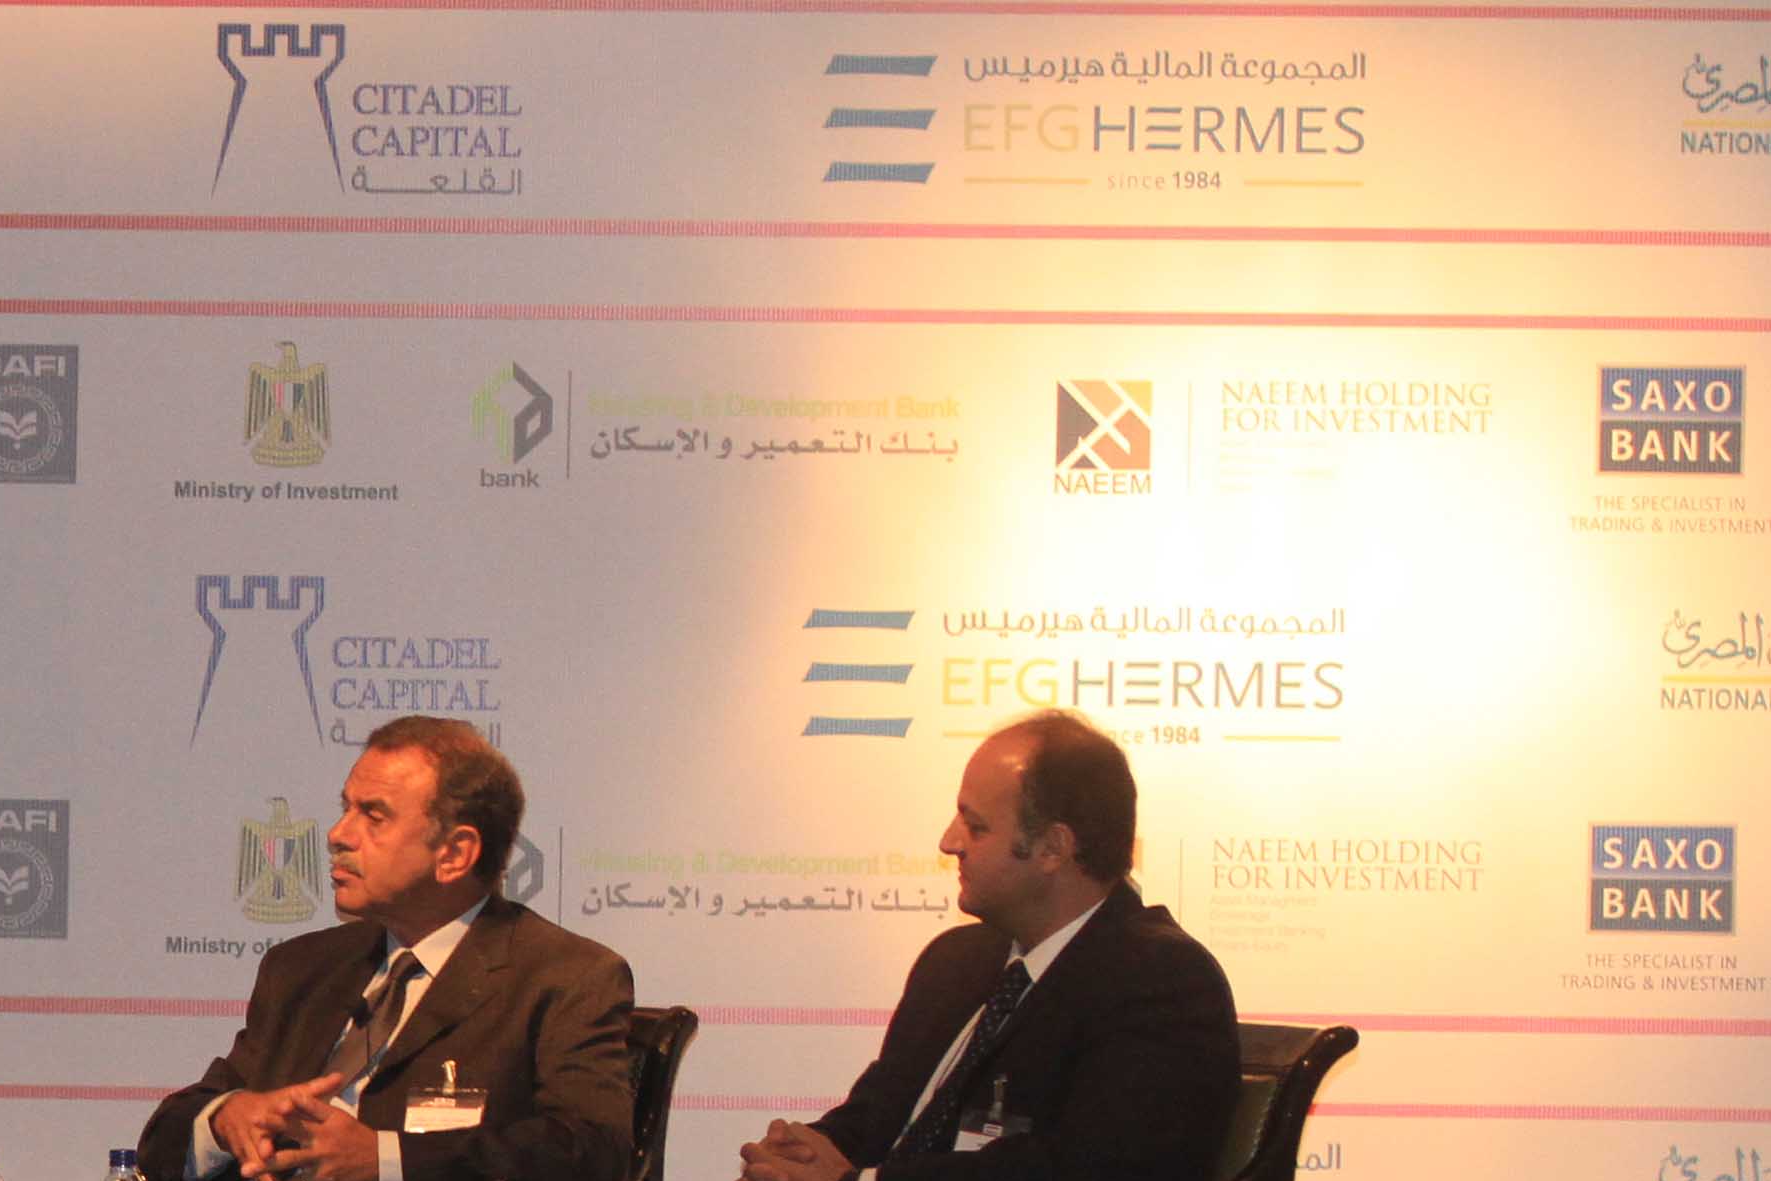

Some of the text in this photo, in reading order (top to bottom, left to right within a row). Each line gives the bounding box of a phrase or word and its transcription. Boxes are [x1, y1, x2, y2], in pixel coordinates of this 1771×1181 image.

[964, 49, 1367, 86] المجموعة المالية هيرميس
[352, 83, 523, 117] CITADEL
[351, 124, 522, 158] CAPITAL
[351, 164, 522, 196] القلعة
[1107, 170, 1221, 190] since 1984
[896, 394, 962, 418] Bank
[1221, 379, 1492, 408] NAEEM HOLDING
[1612, 379, 1732, 412] SAXO
[1221, 407, 1492, 434] FOR INVESTMENT
[741, 429, 873, 461] التعمير
[880, 430, 960, 463] بنك
[1611, 429, 1733, 462] BANK
[174, 481, 399, 503] Ministry of Investment
[479, 468, 541, 489] bank
[1053, 472, 1152, 495] NAEEM
[1594, 494, 1748, 513] THE SPECIALIST IN
[1568, 514, 1644, 533] TRADING
[1651, 517, 1664, 533] &
[943, 604, 1346, 639] المجموعة المالية هيرميس
[332, 635, 503, 670] CITADEL
[332, 677, 503, 711] CAPITAL
[1660, 687, 1771, 712] NATIONA
[1150, 724, 1201, 745] 1984
[1212, 837, 1484, 866] NAEEM HOLDING
[1603, 837, 1724, 870] SAXO
[1213, 865, 1484, 892] FOR INVESTMENT
[732, 885, 865, 917] التعمير
[871, 887, 951, 919] بنك
[1603, 888, 1723, 920] BANK
[165, 936, 246, 958] Ministry
[1586, 952, 1739, 971] THE SPECIALIST IN
[1559, 973, 1767, 993] TRADING & INVESTMENT
